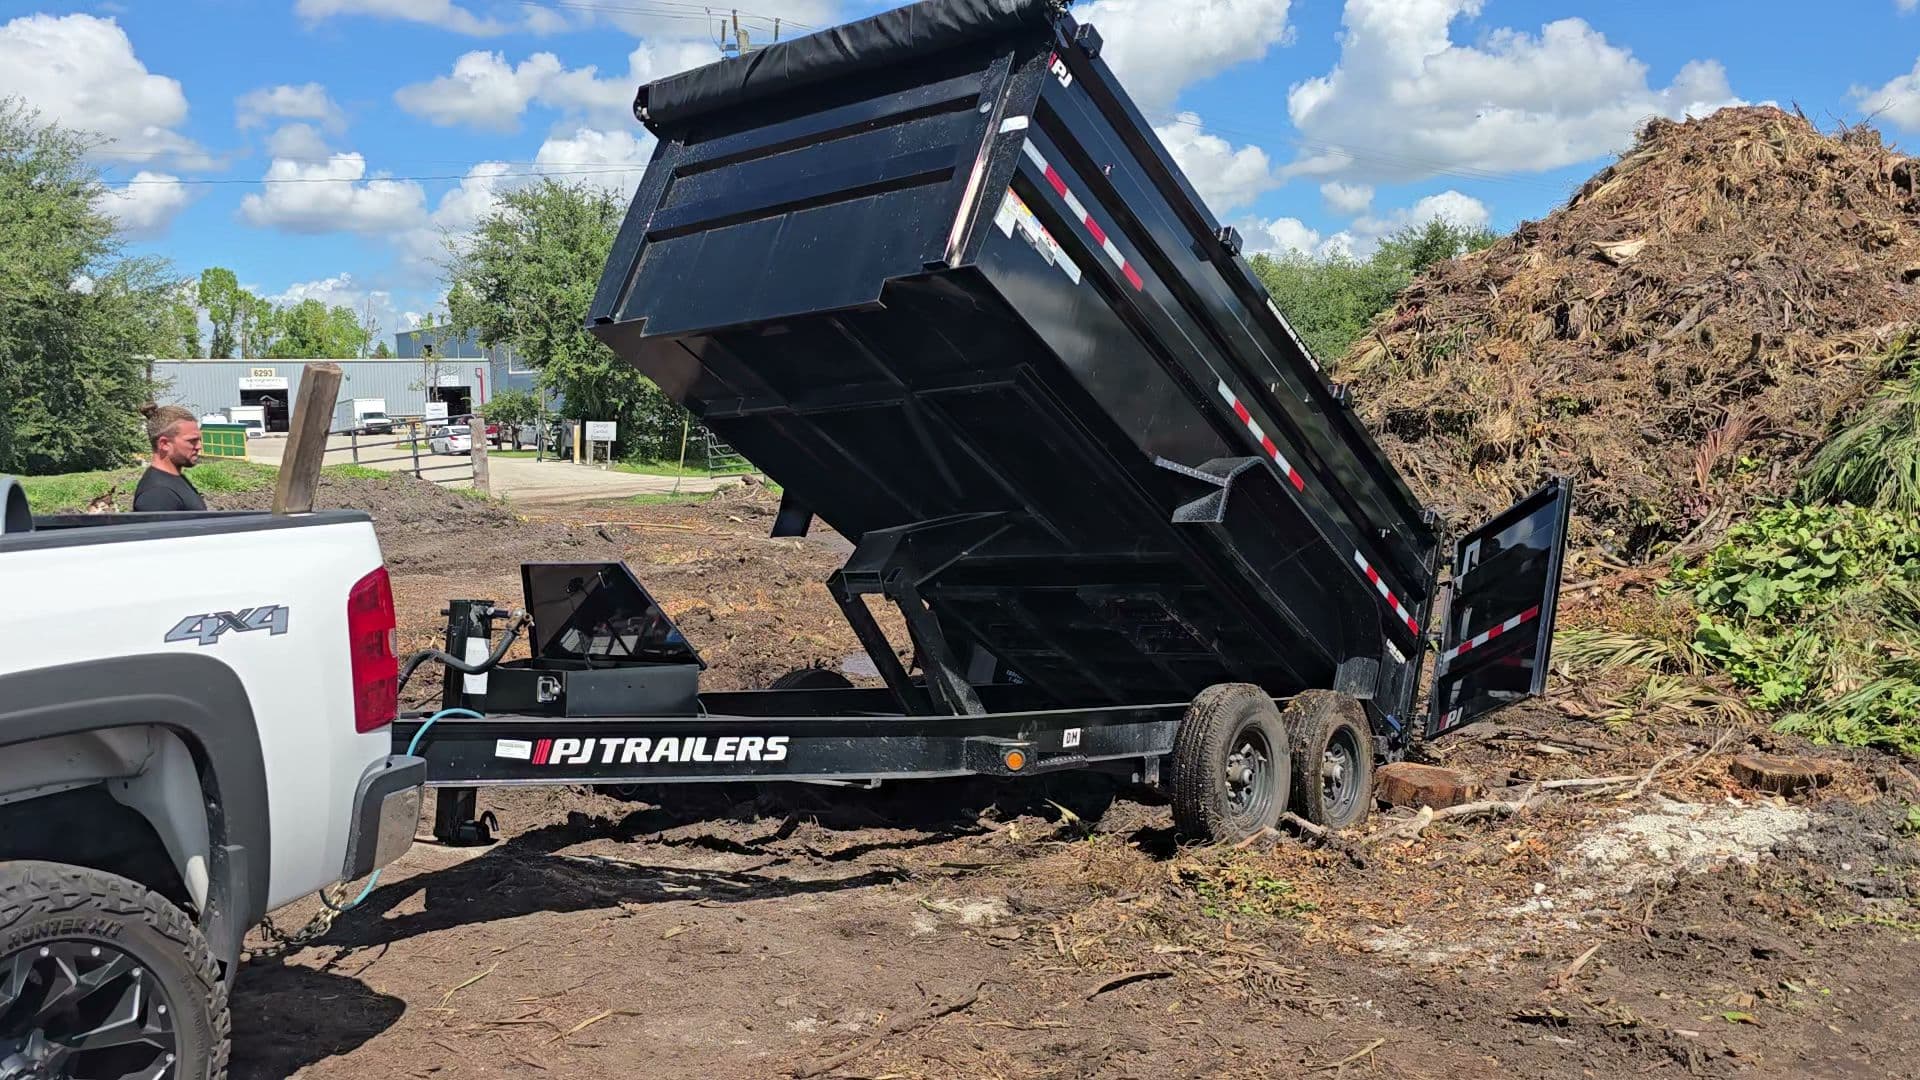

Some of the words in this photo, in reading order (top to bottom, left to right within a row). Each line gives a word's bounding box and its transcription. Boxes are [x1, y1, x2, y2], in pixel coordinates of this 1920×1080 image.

[1051, 58, 1073, 88] PJ
[254, 369, 273, 377] 6293
[1444, 705, 1464, 729] PJ
[599, 736, 790, 764] TRAILERS
